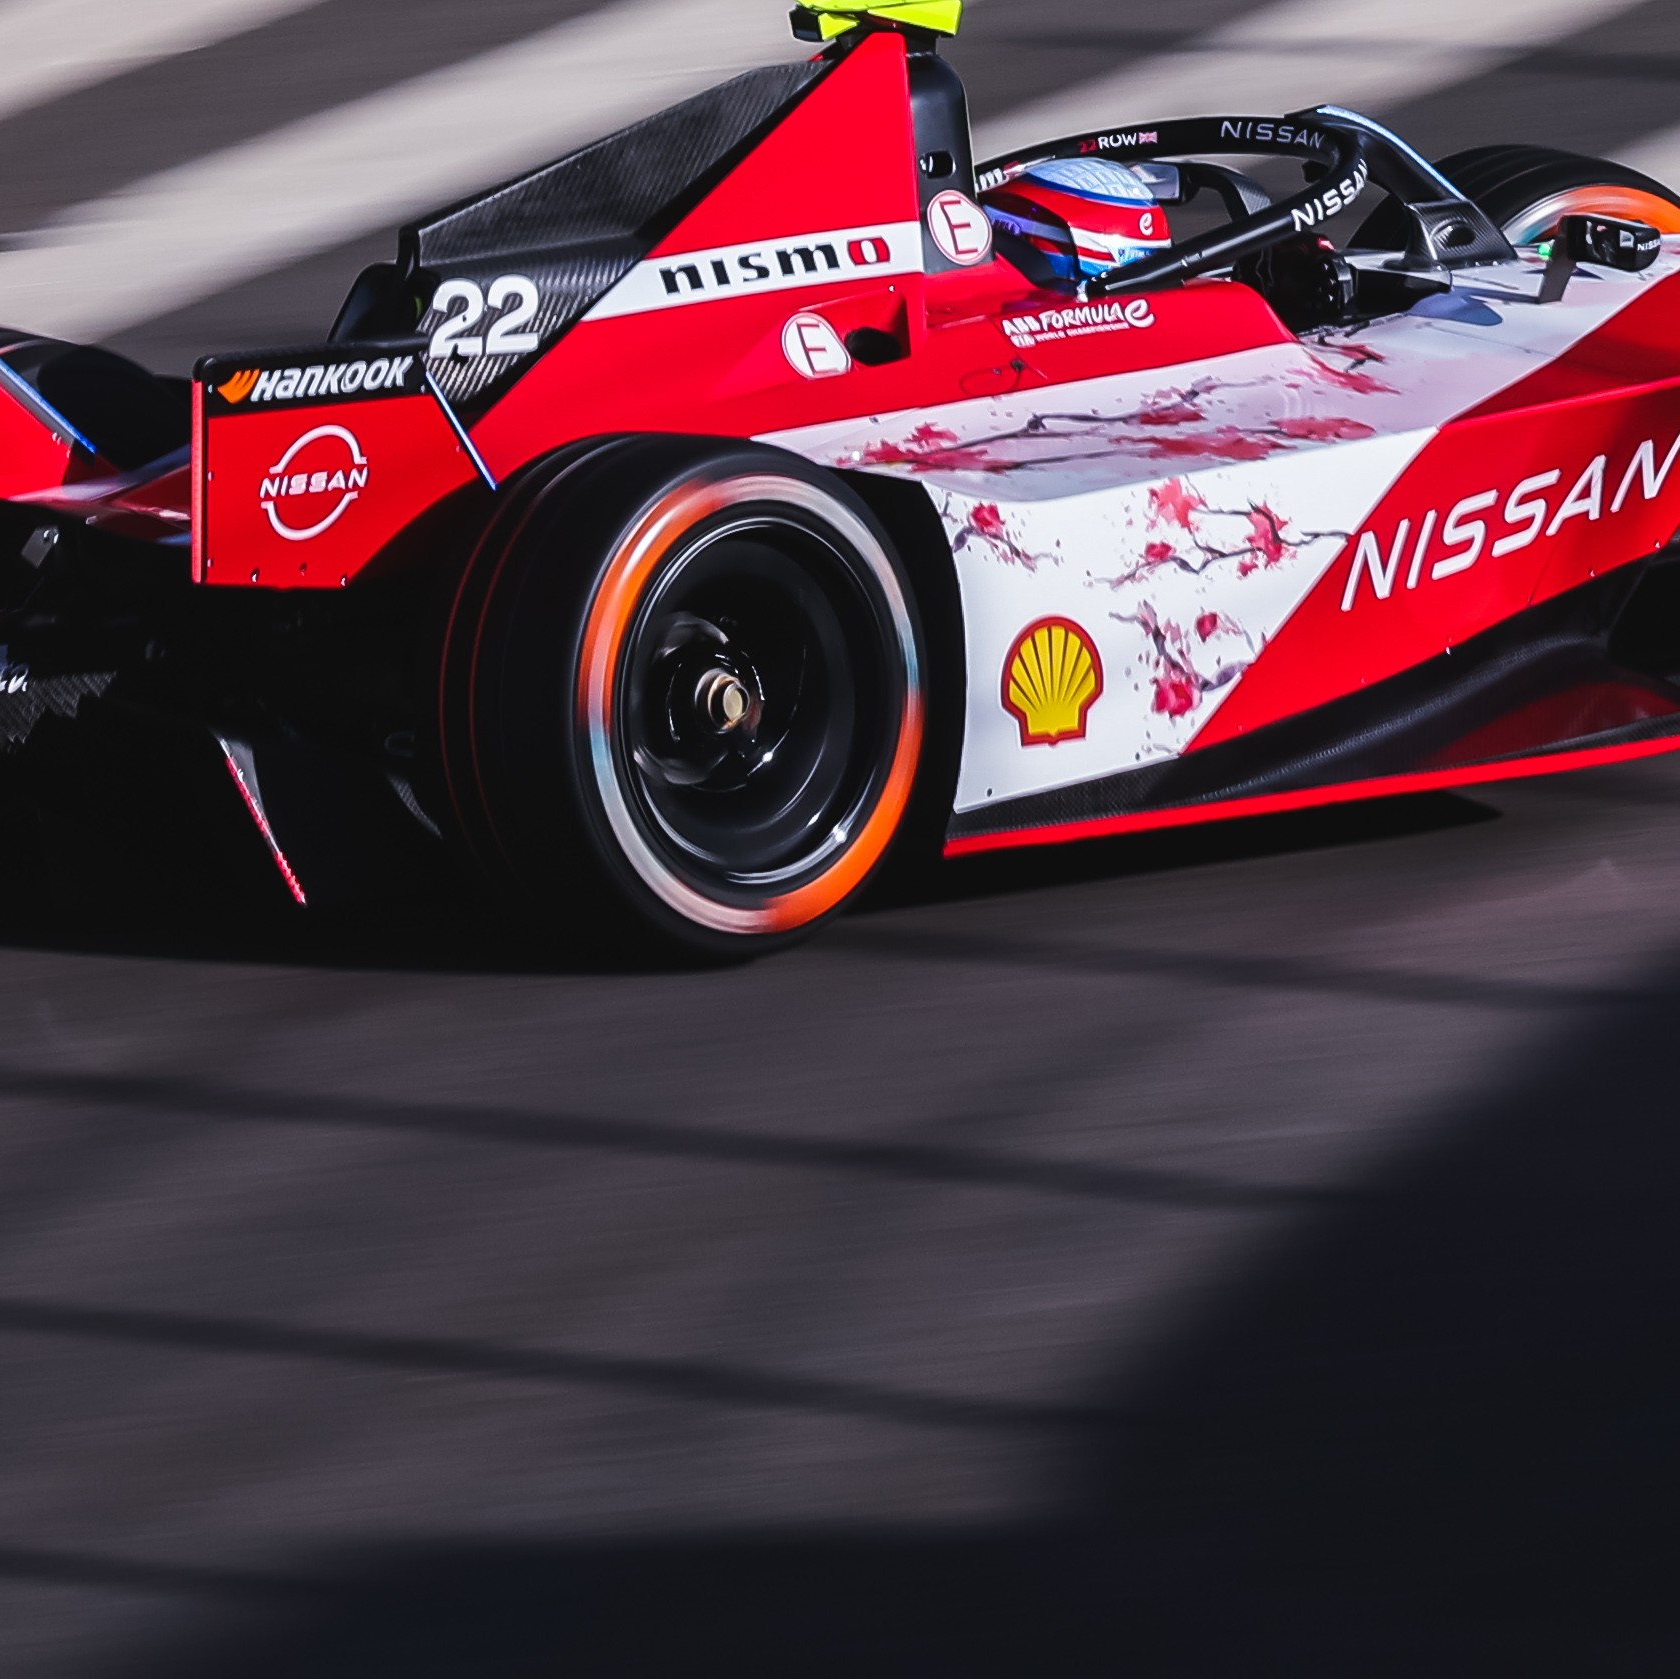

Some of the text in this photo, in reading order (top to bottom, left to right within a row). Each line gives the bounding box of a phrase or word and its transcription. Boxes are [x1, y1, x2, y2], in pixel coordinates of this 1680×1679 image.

[1098, 132, 1137, 150] ROW
[1220, 120, 1325, 150] NISSAN
[1290, 158, 1368, 232] NISSAN
[1636, 238, 1661, 251] NISSA
[429, 273, 540, 359] 22
[1038, 302, 1125, 331] FORMULA
[259, 467, 368, 499] NISSAN
